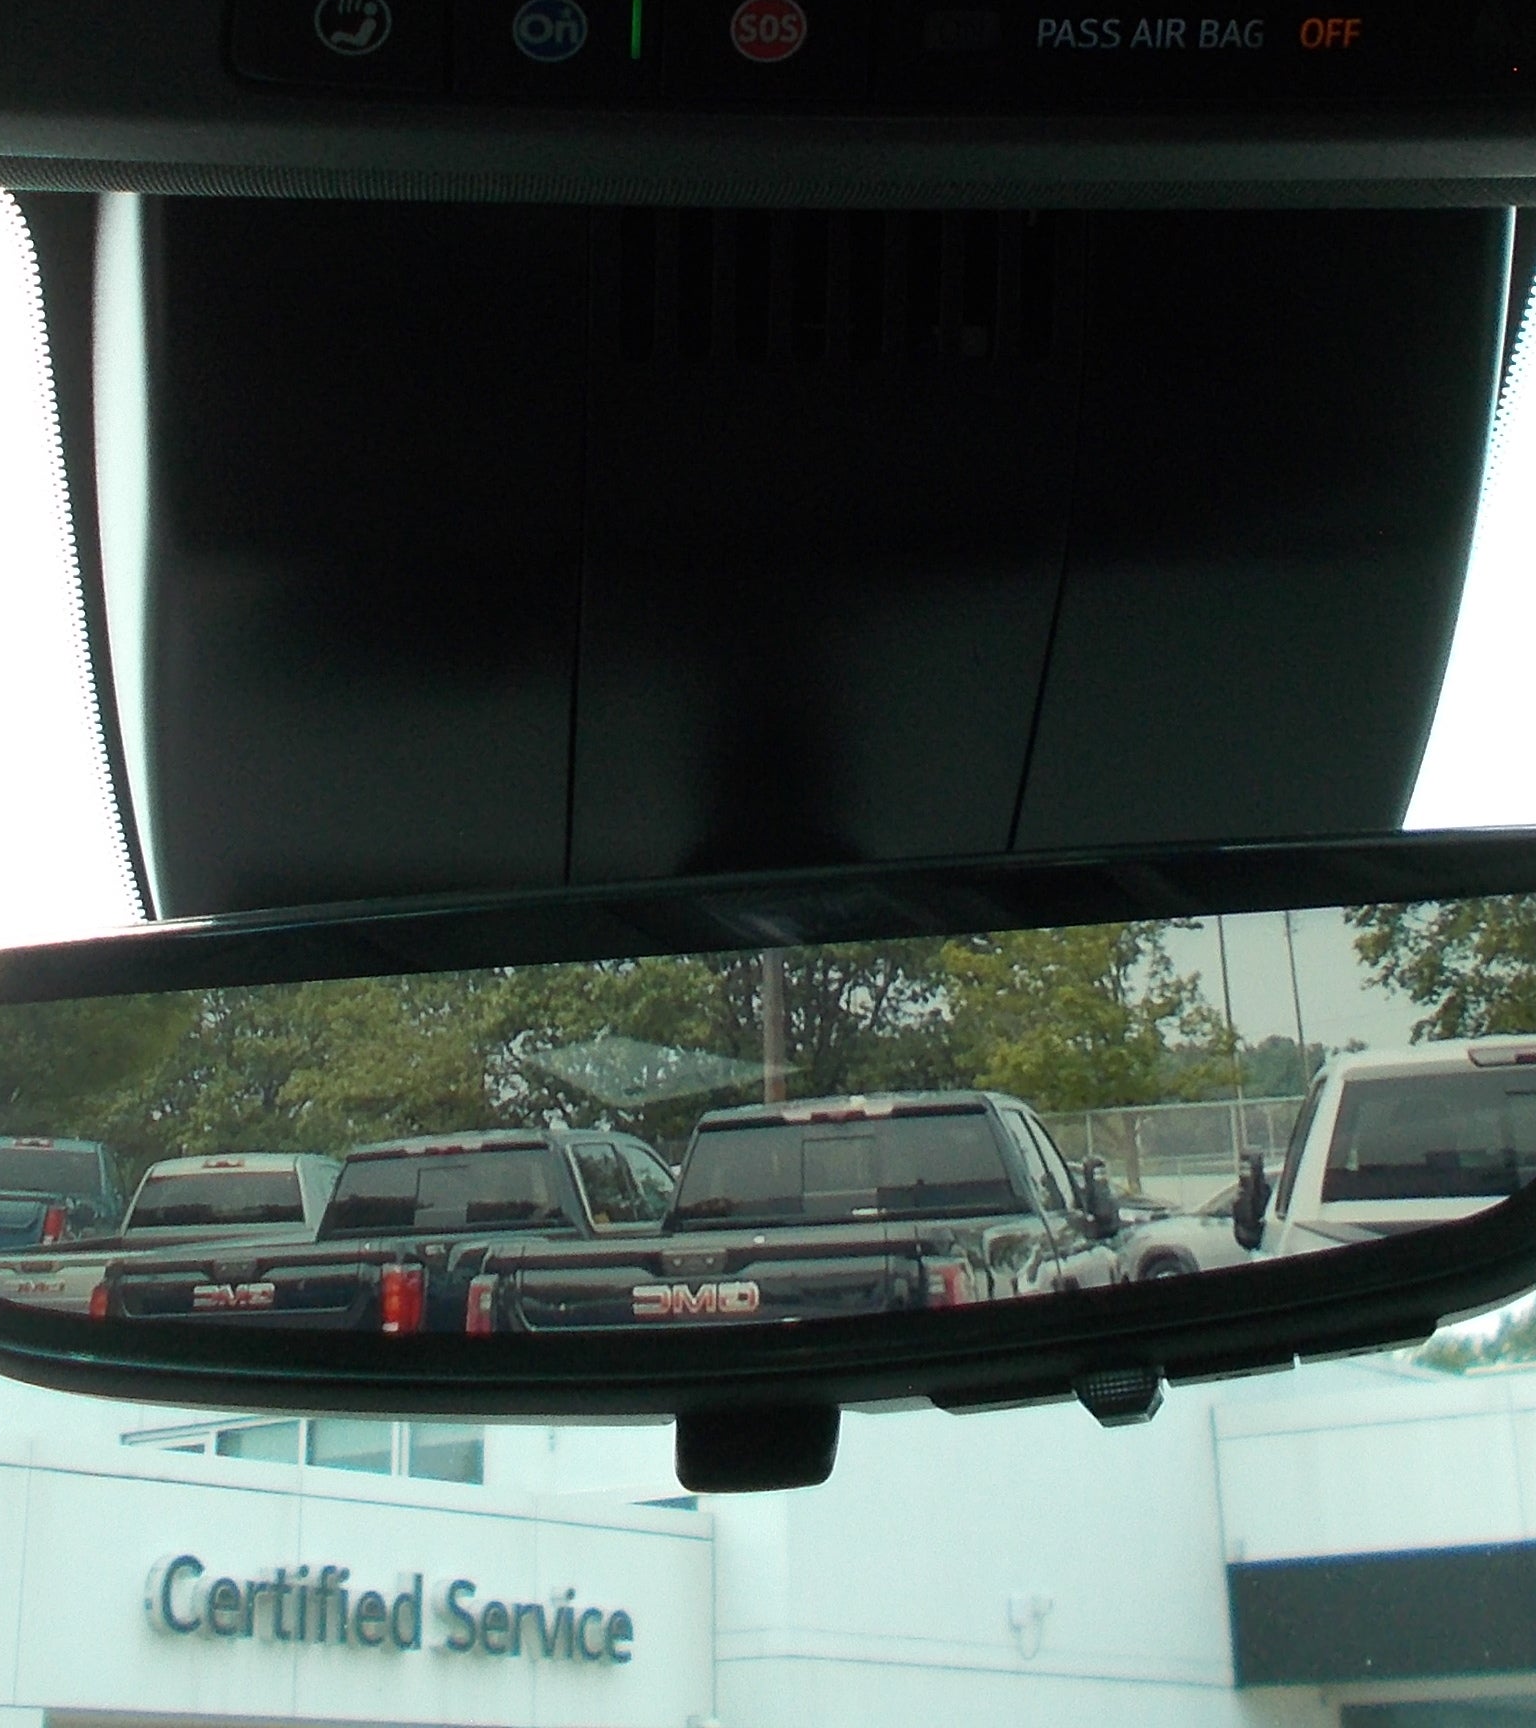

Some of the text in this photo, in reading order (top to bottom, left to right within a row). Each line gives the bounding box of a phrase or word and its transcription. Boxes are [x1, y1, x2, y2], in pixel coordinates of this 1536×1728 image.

[737, 13, 798, 44] SOS
[1036, 16, 1362, 50] PASS AIR BAG OFF
[152, 1552, 636, 1664] Certified Service
